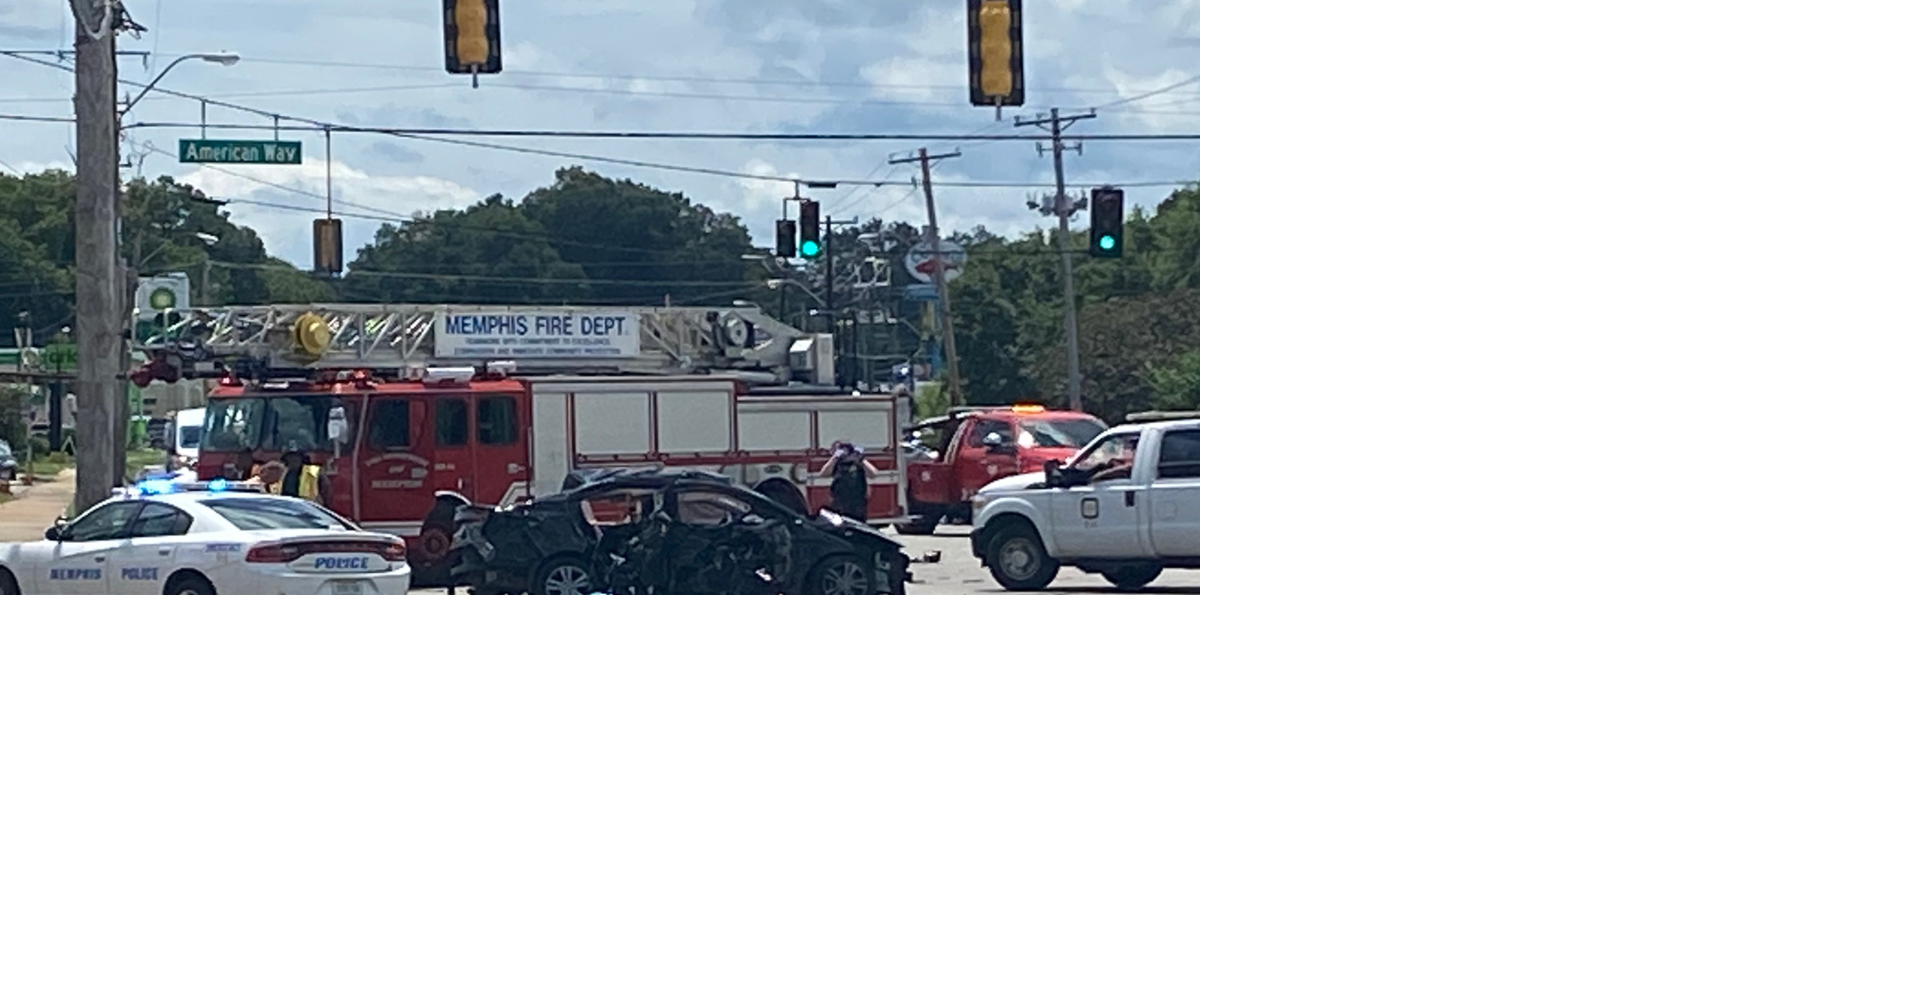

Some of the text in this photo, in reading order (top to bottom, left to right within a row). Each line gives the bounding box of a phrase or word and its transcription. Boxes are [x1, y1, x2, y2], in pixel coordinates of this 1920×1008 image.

[186, 142, 297, 162] American Way
[445, 315, 527, 336] MEMPHIS
[535, 316, 573, 336] FIRE
[314, 557, 369, 569] POLICE
[50, 567, 159, 581] MEMPHIS POLICE
